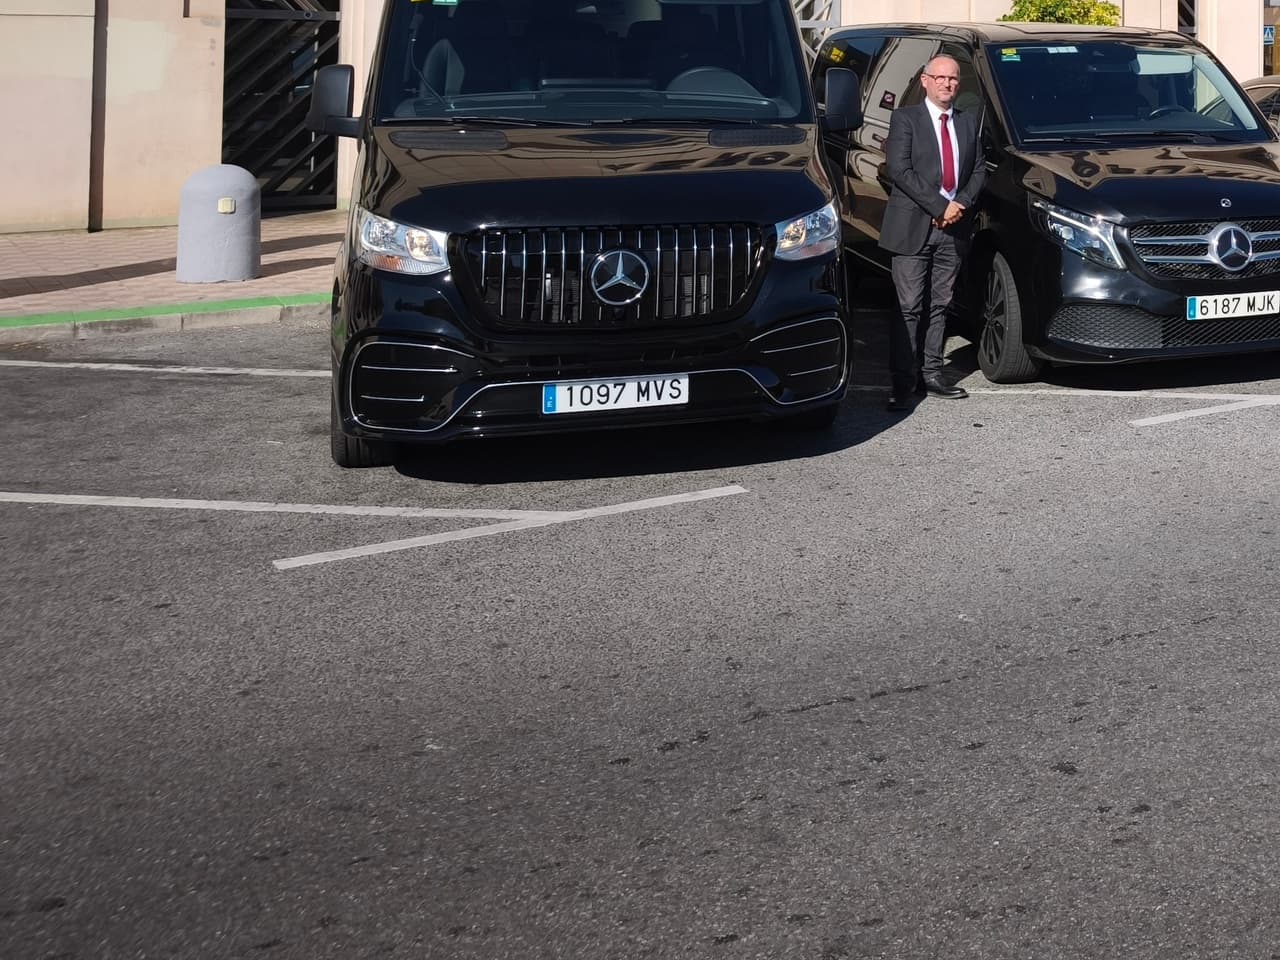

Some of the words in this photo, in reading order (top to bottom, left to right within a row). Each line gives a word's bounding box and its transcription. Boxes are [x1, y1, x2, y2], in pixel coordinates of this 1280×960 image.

[1200, 297, 1241, 316] 6187
[1246, 294, 1276, 313] MJK
[566, 382, 626, 407] 1097
[636, 378, 682, 402] MVS
